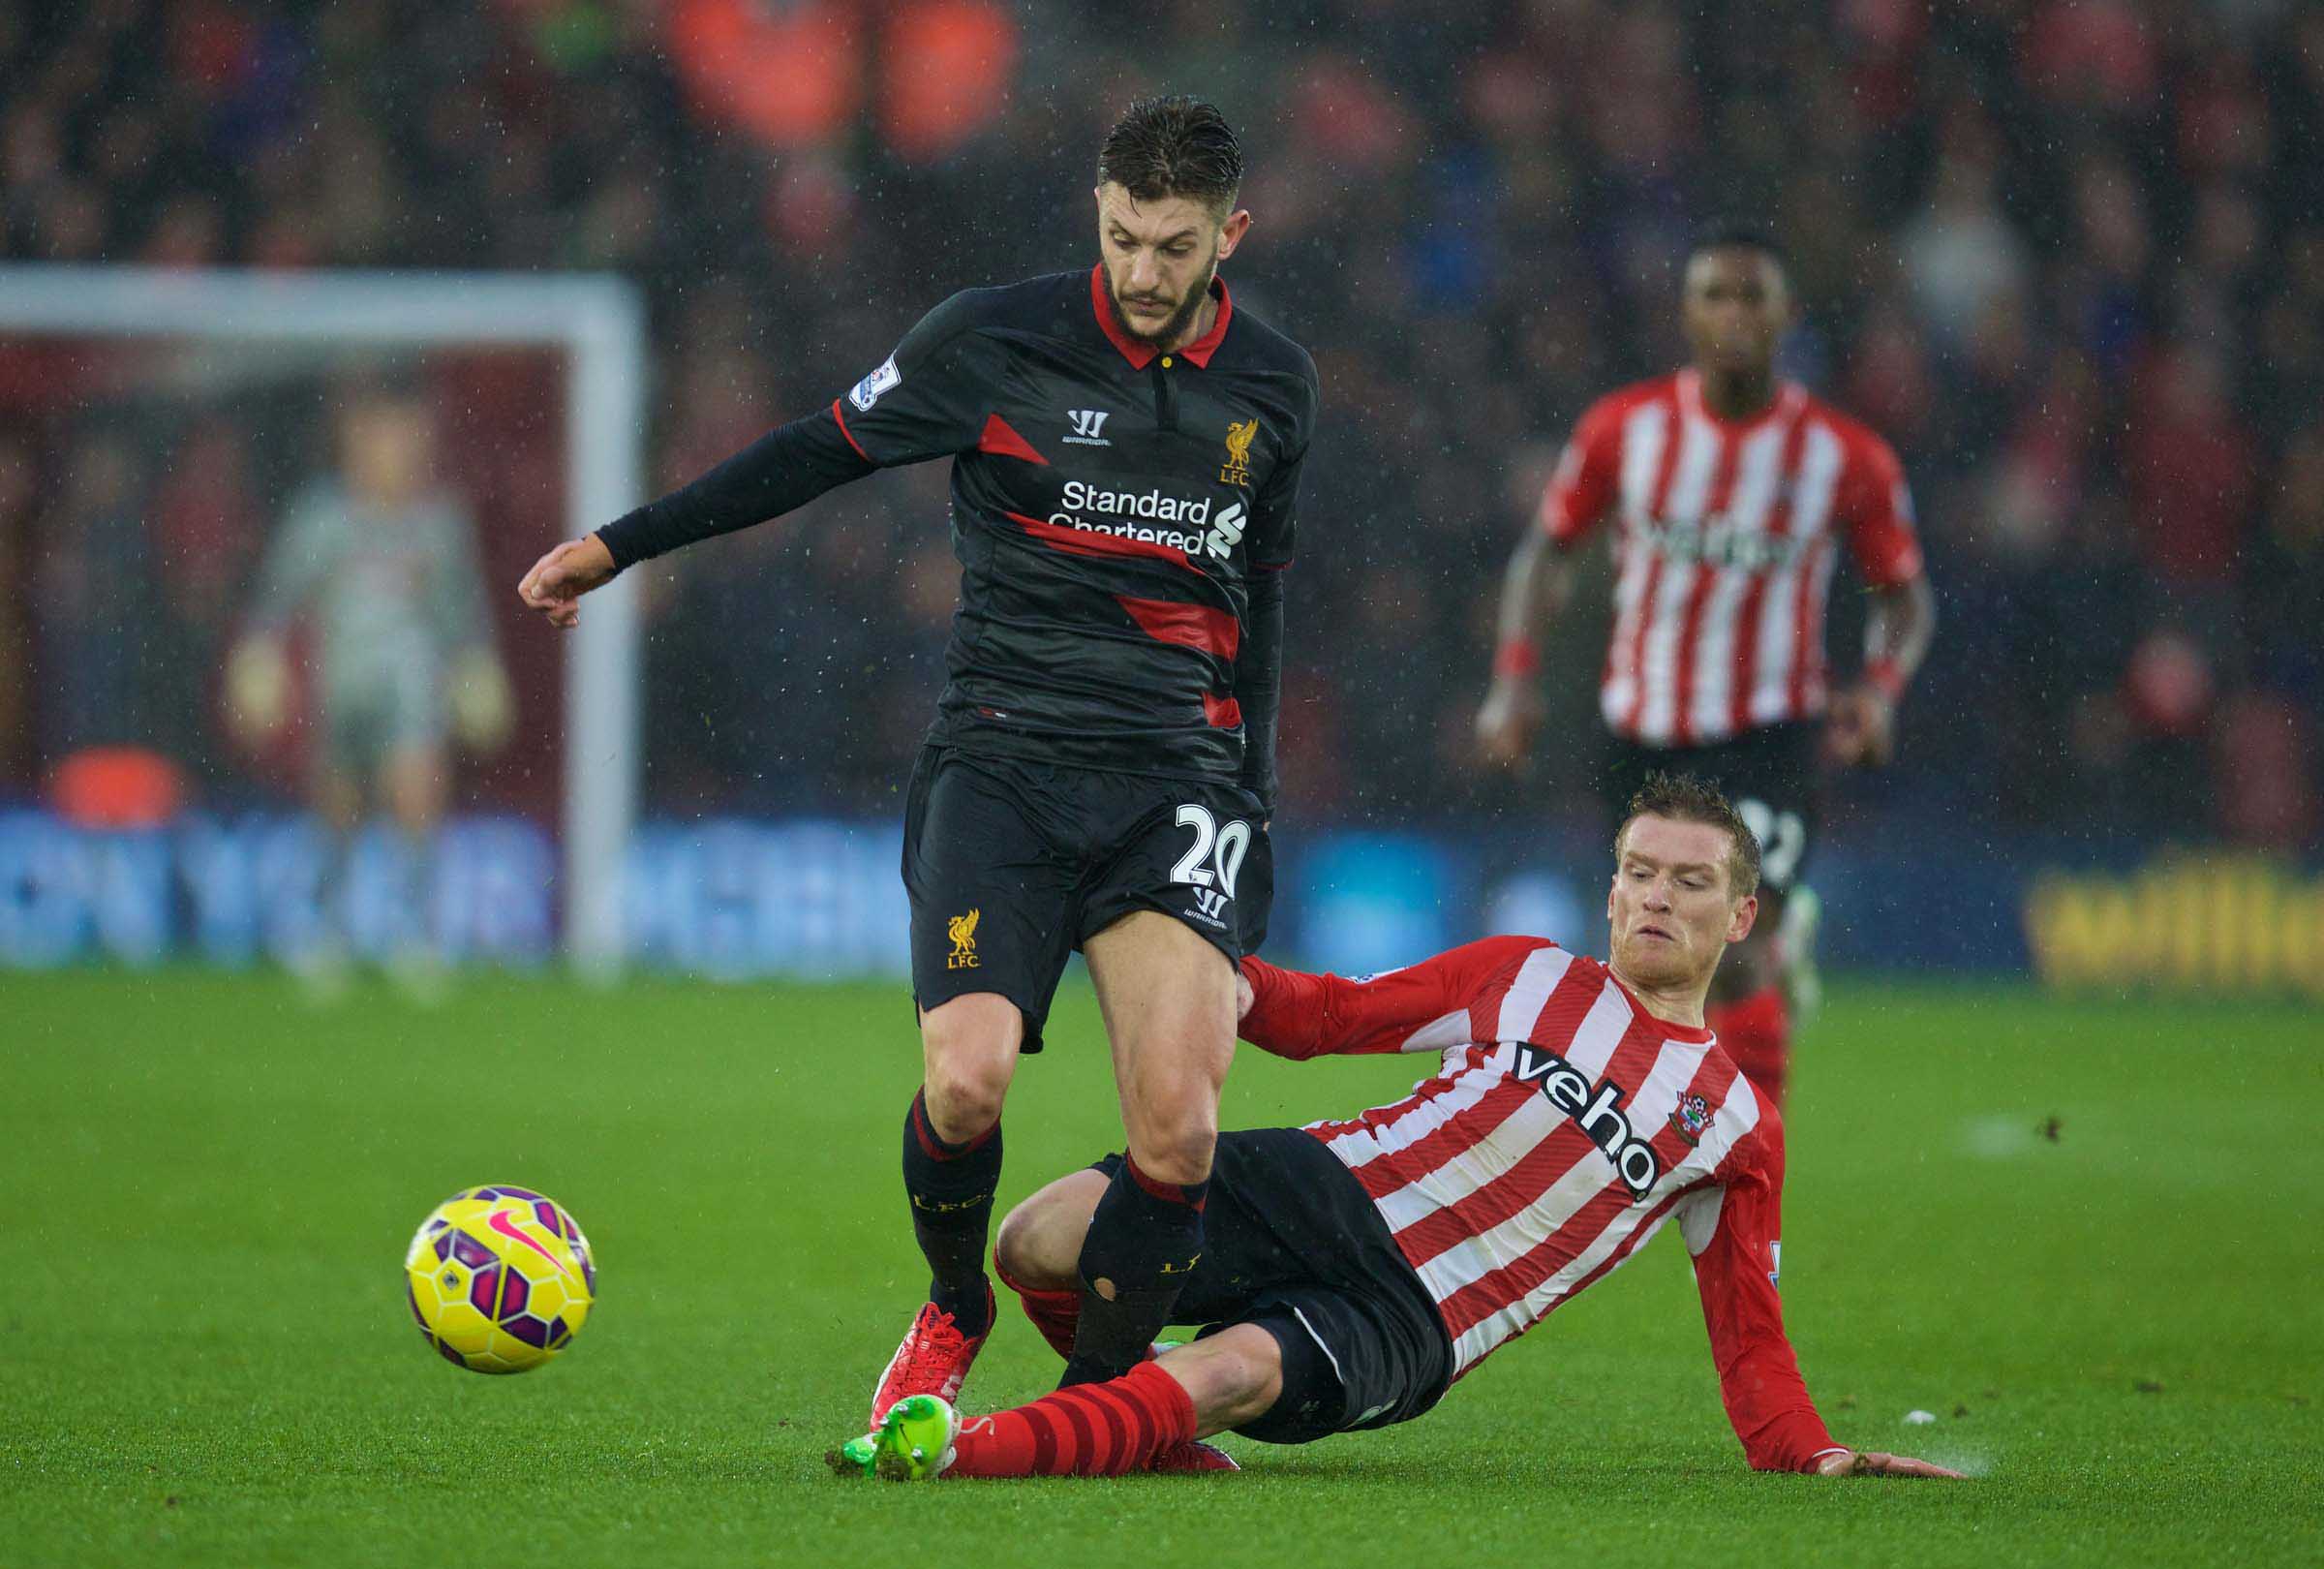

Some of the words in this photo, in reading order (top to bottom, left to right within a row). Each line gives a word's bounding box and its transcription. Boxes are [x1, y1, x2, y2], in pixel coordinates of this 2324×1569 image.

[1061, 480, 1210, 526] Standard
[1170, 803, 1251, 902] 20
[1183, 908, 1227, 930] WARRIOR
[1517, 1048, 1656, 1191] veho
